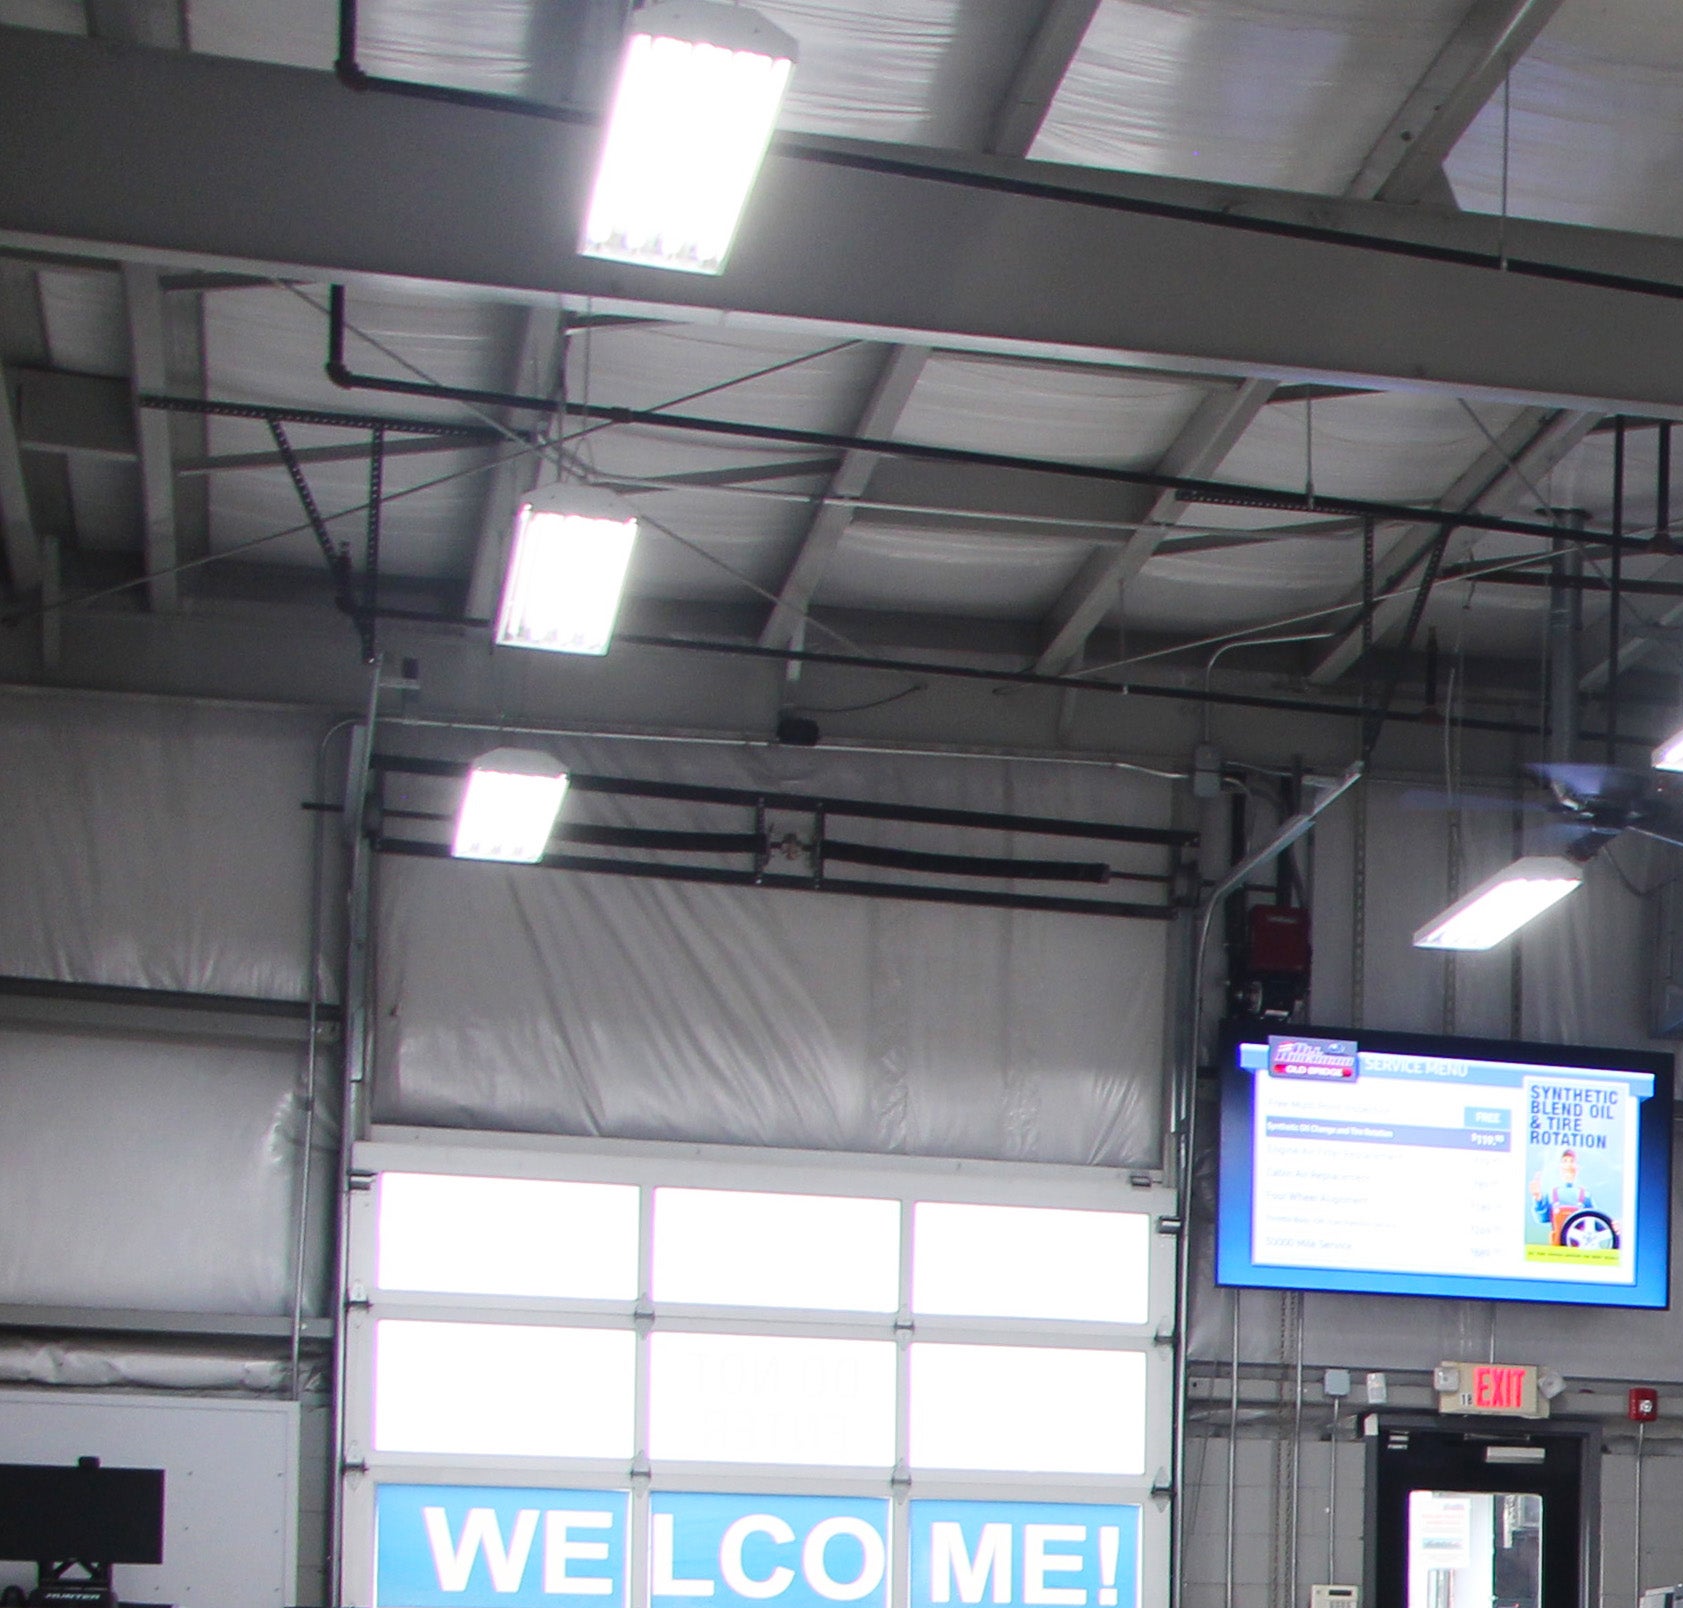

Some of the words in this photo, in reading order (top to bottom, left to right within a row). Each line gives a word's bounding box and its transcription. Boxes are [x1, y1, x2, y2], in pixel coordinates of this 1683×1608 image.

[1285, 1065, 1306, 1074] OLD
[1308, 1067, 1343, 1076] BRIDGE
[1364, 1057, 1422, 1074] SERVICE
[1425, 1063, 1469, 1078] MENU
[1531, 1085, 1618, 1105] SYNTHETIC
[1476, 1112, 1500, 1123] FREE
[1531, 1100, 1582, 1117] BLEND
[1590, 1104, 1614, 1119] OIL
[1530, 1115, 1541, 1129] &
[1547, 1116, 1582, 1132] TIRE
[1530, 1130, 1607, 1149] ROTATION
[1474, 1366, 1527, 1409] EXIT
